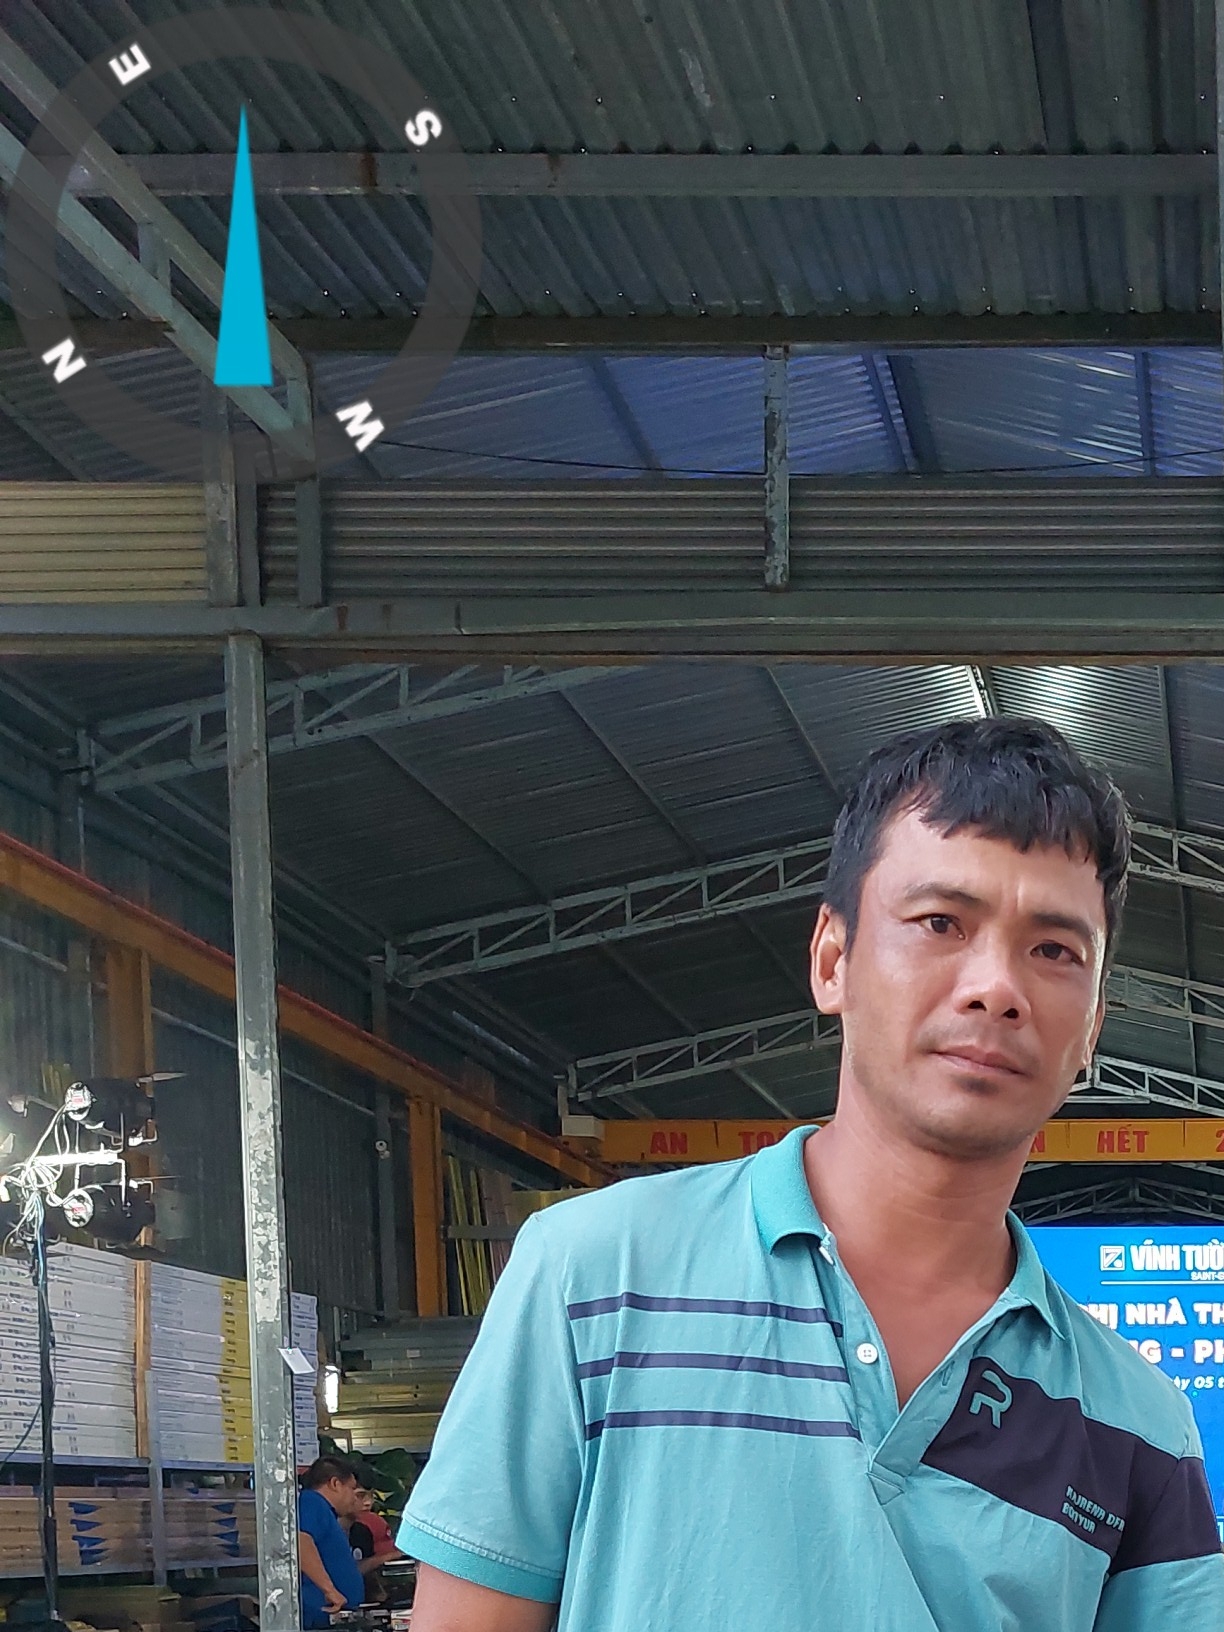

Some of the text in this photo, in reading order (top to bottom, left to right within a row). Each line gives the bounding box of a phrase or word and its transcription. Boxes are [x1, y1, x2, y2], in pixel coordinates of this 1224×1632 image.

[650, 1131, 688, 1155] AN
[1097, 1124, 1149, 1153] HẾT
[1126, 1298, 1187, 1325] NHÀ
[1194, 1376, 1214, 1389] 05
